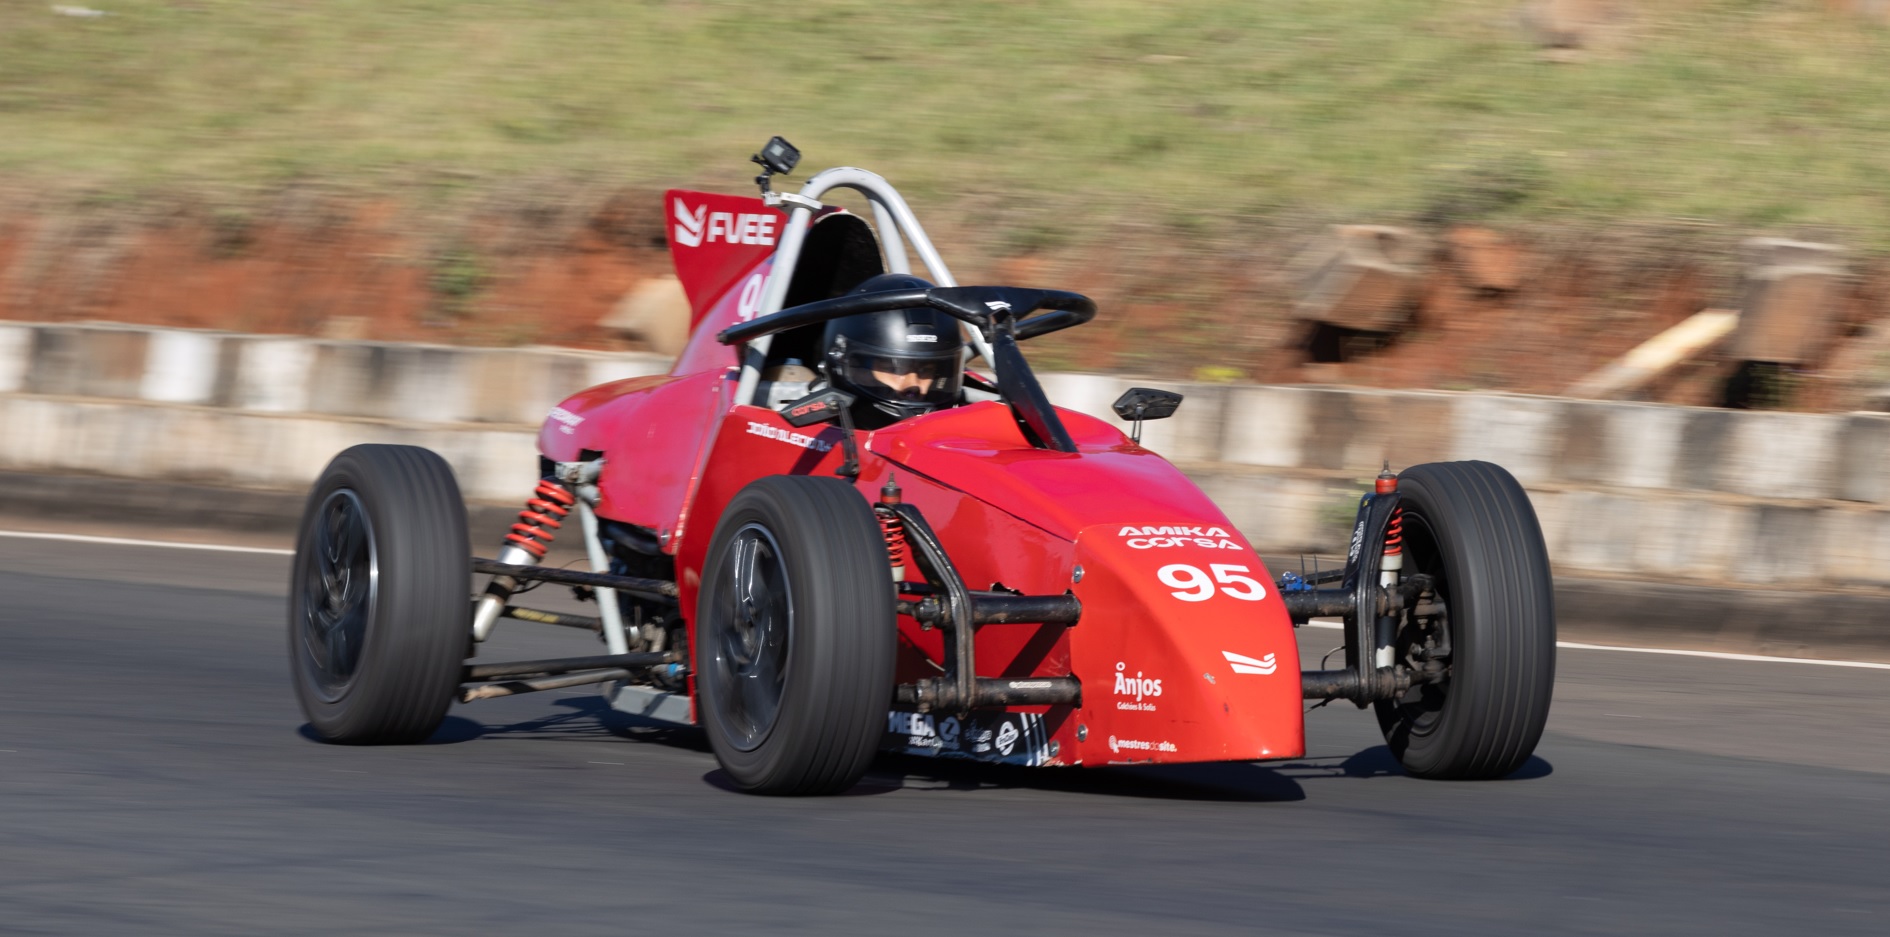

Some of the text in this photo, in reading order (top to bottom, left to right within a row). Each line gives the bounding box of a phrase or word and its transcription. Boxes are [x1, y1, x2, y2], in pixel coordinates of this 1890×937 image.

[707, 211, 777, 246] FVEE
[1118, 526, 1231, 538] AMIKA
[1157, 563, 1266, 602] 95
[888, 711, 936, 737] MEGA
